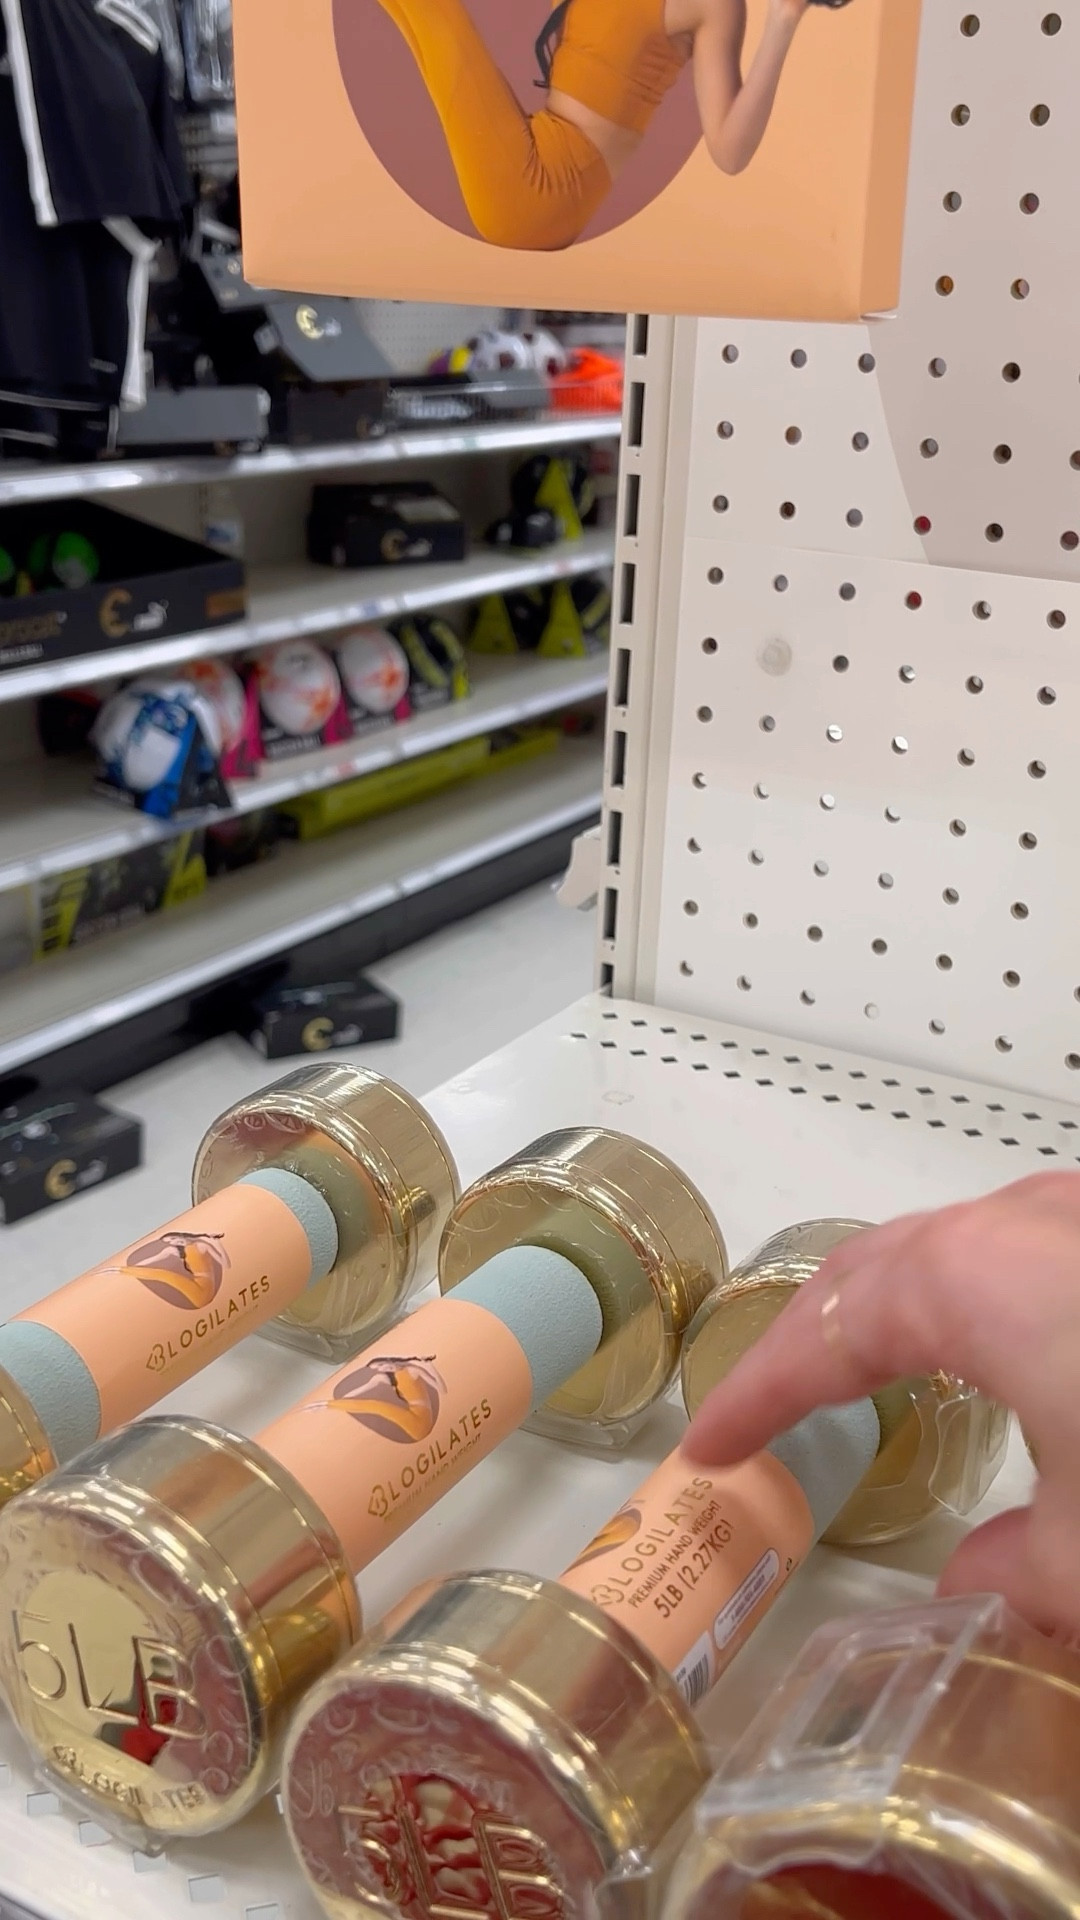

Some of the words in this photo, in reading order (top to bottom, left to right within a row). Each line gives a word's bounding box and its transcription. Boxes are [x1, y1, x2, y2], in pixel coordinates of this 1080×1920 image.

[627, 1563, 670, 1608] PREMIUM
[664, 1534, 693, 1564] HAND
[687, 1500, 721, 1536] WEIGHT
[653, 1584, 684, 1618] 5LB
